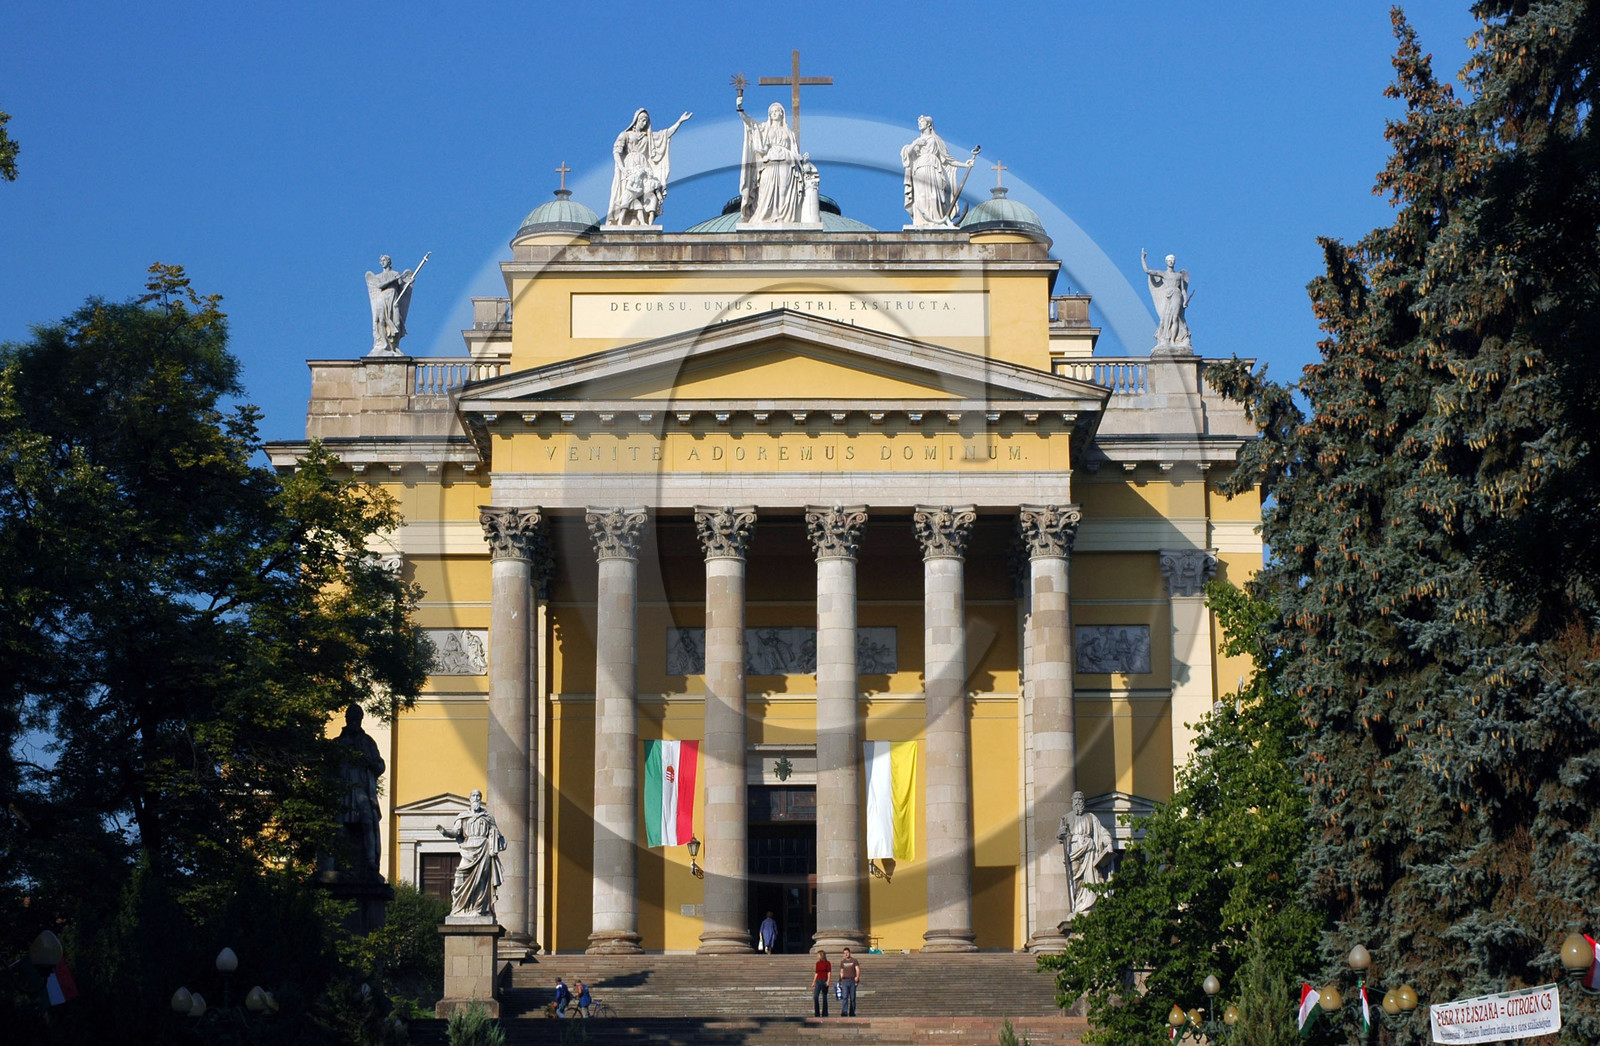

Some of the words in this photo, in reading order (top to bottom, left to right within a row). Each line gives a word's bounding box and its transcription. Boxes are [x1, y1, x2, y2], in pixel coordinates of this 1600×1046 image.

[610, 301, 692, 312] DECURSU.
[703, 301, 758, 311] UNIUS.
[849, 300, 956, 311] EXSTRUCTA.
[543, 446, 662, 461] VENITE
[687, 446, 855, 461] ADOREMUS
[880, 445, 1029, 461] DOMINUM.
[1541, 993, 1552, 1011] C3
